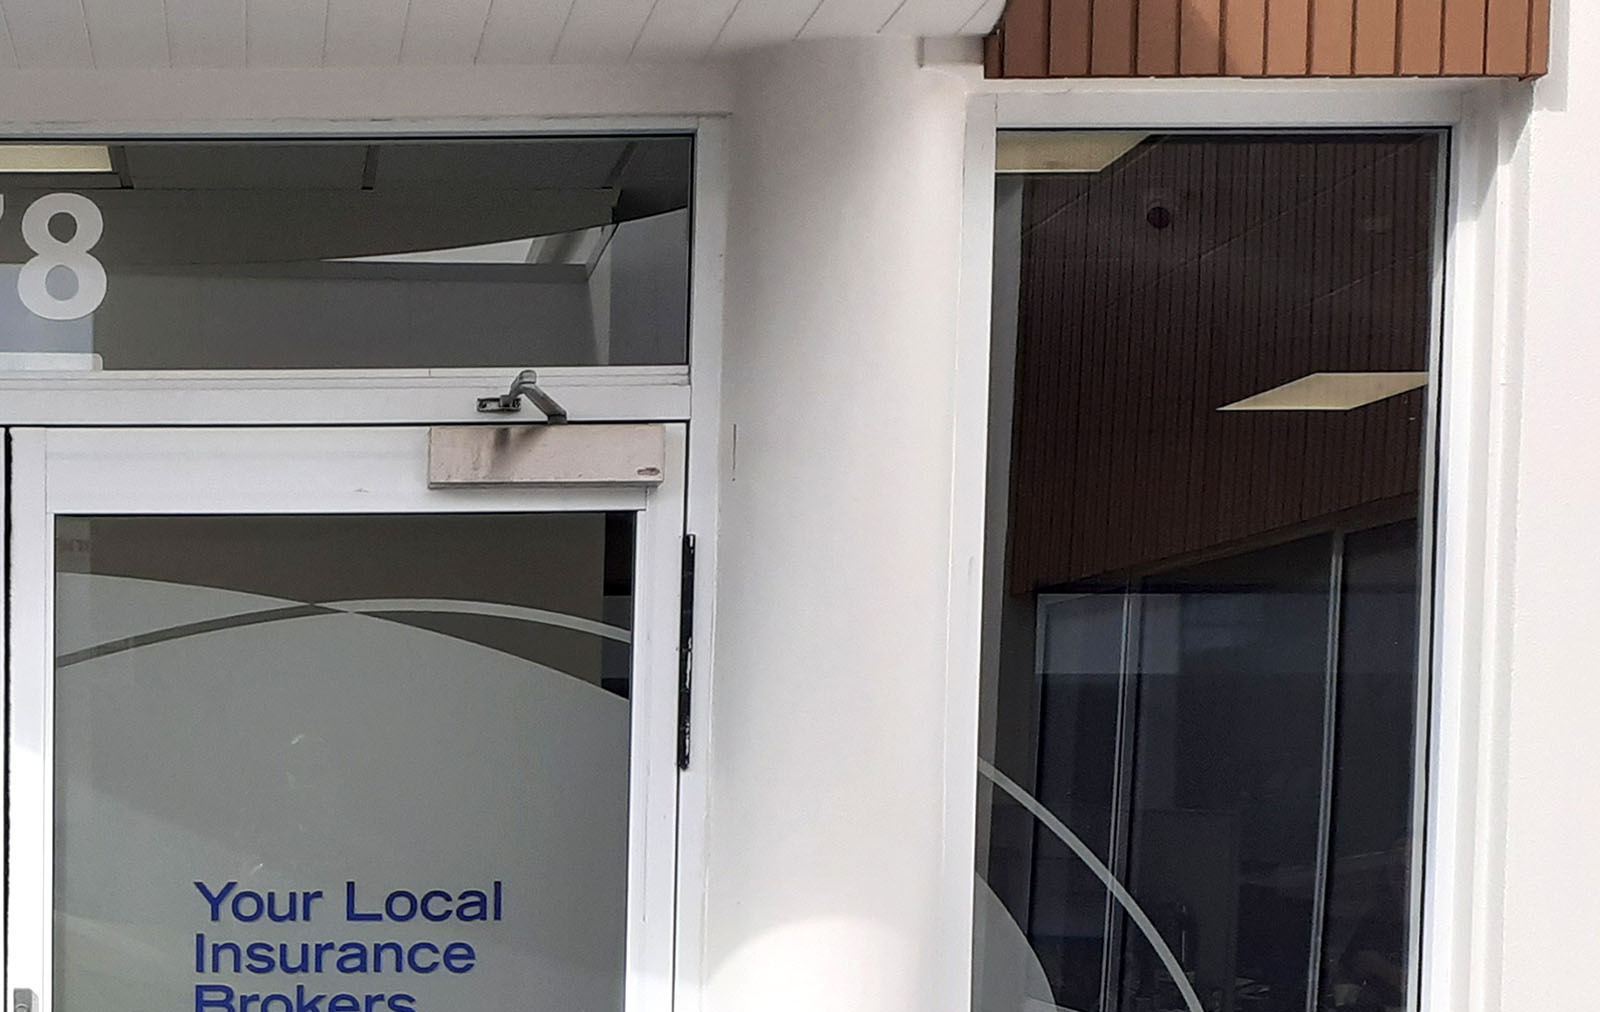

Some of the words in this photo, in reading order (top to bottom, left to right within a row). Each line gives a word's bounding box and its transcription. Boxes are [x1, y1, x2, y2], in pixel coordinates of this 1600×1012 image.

[195, 881, 322, 922] Your
[346, 881, 503, 921] Local
[195, 932, 477, 973] Insurance
